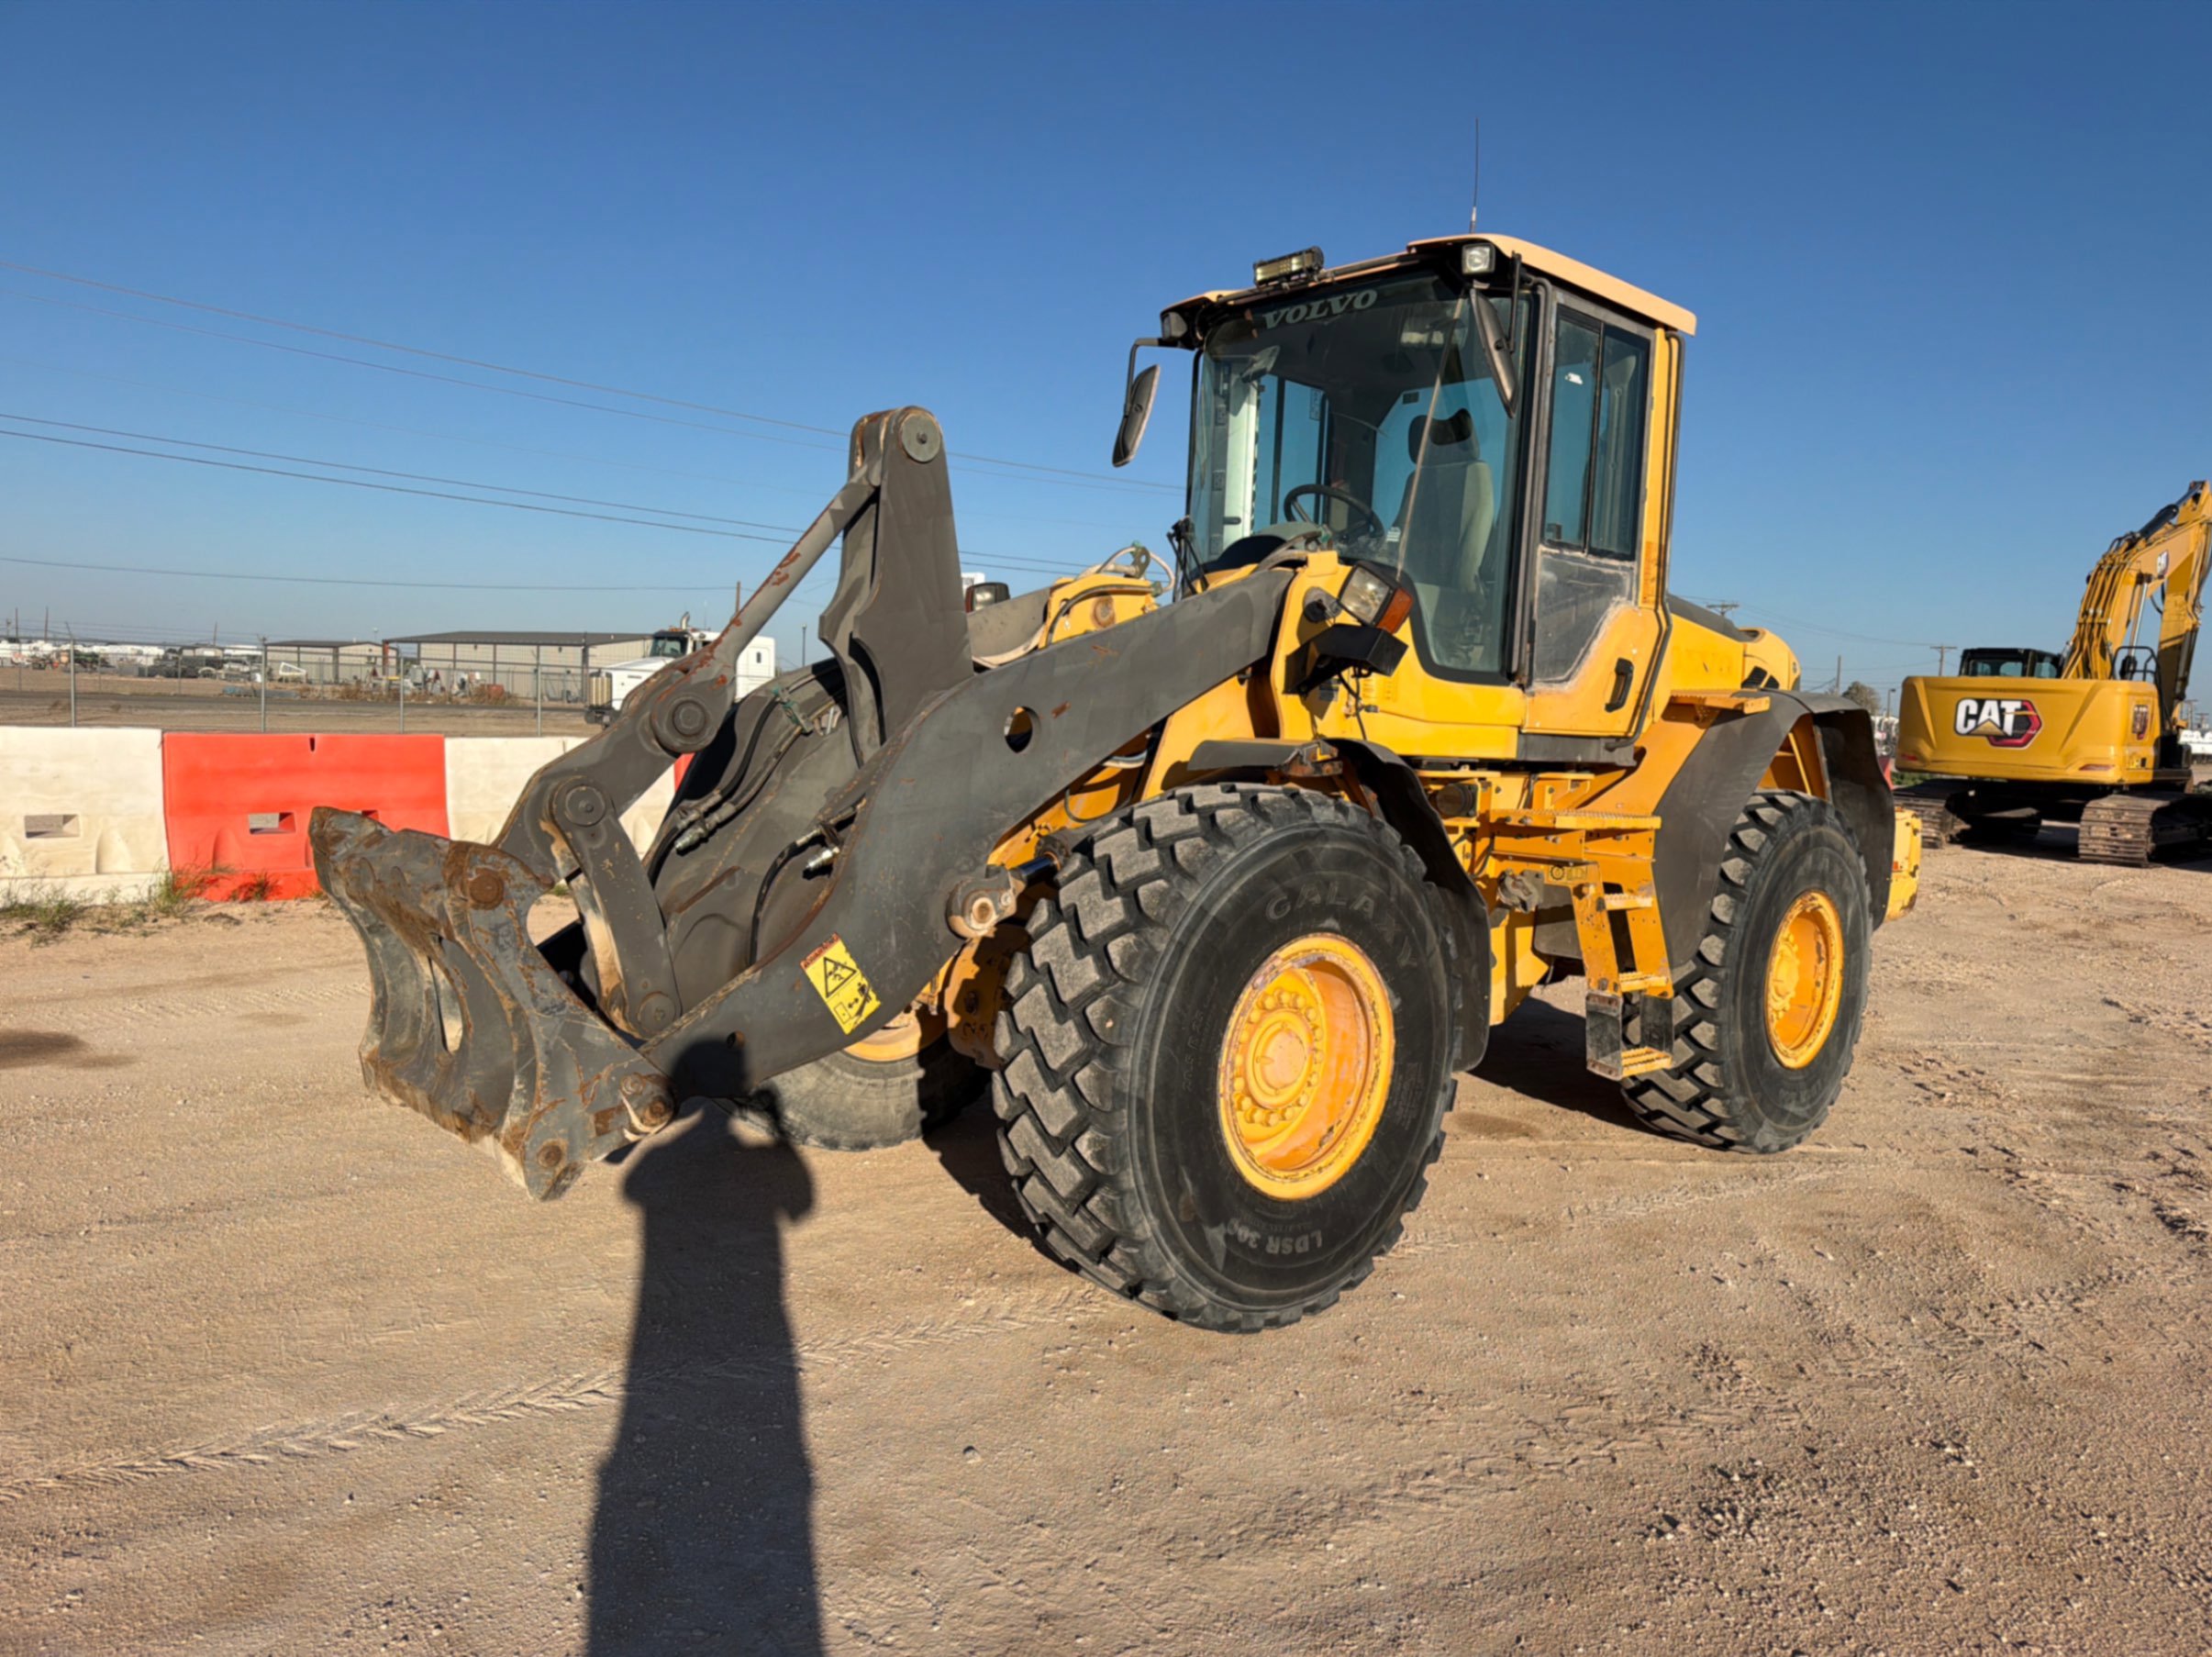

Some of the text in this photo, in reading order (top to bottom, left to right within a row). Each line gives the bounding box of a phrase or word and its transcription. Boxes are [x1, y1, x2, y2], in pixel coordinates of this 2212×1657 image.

[1262, 289, 1377, 329] VOLVO
[1955, 698, 2022, 736] CAT
[1265, 879, 1417, 967] GALAXY
[1265, 1229, 1323, 1255] LDSR
